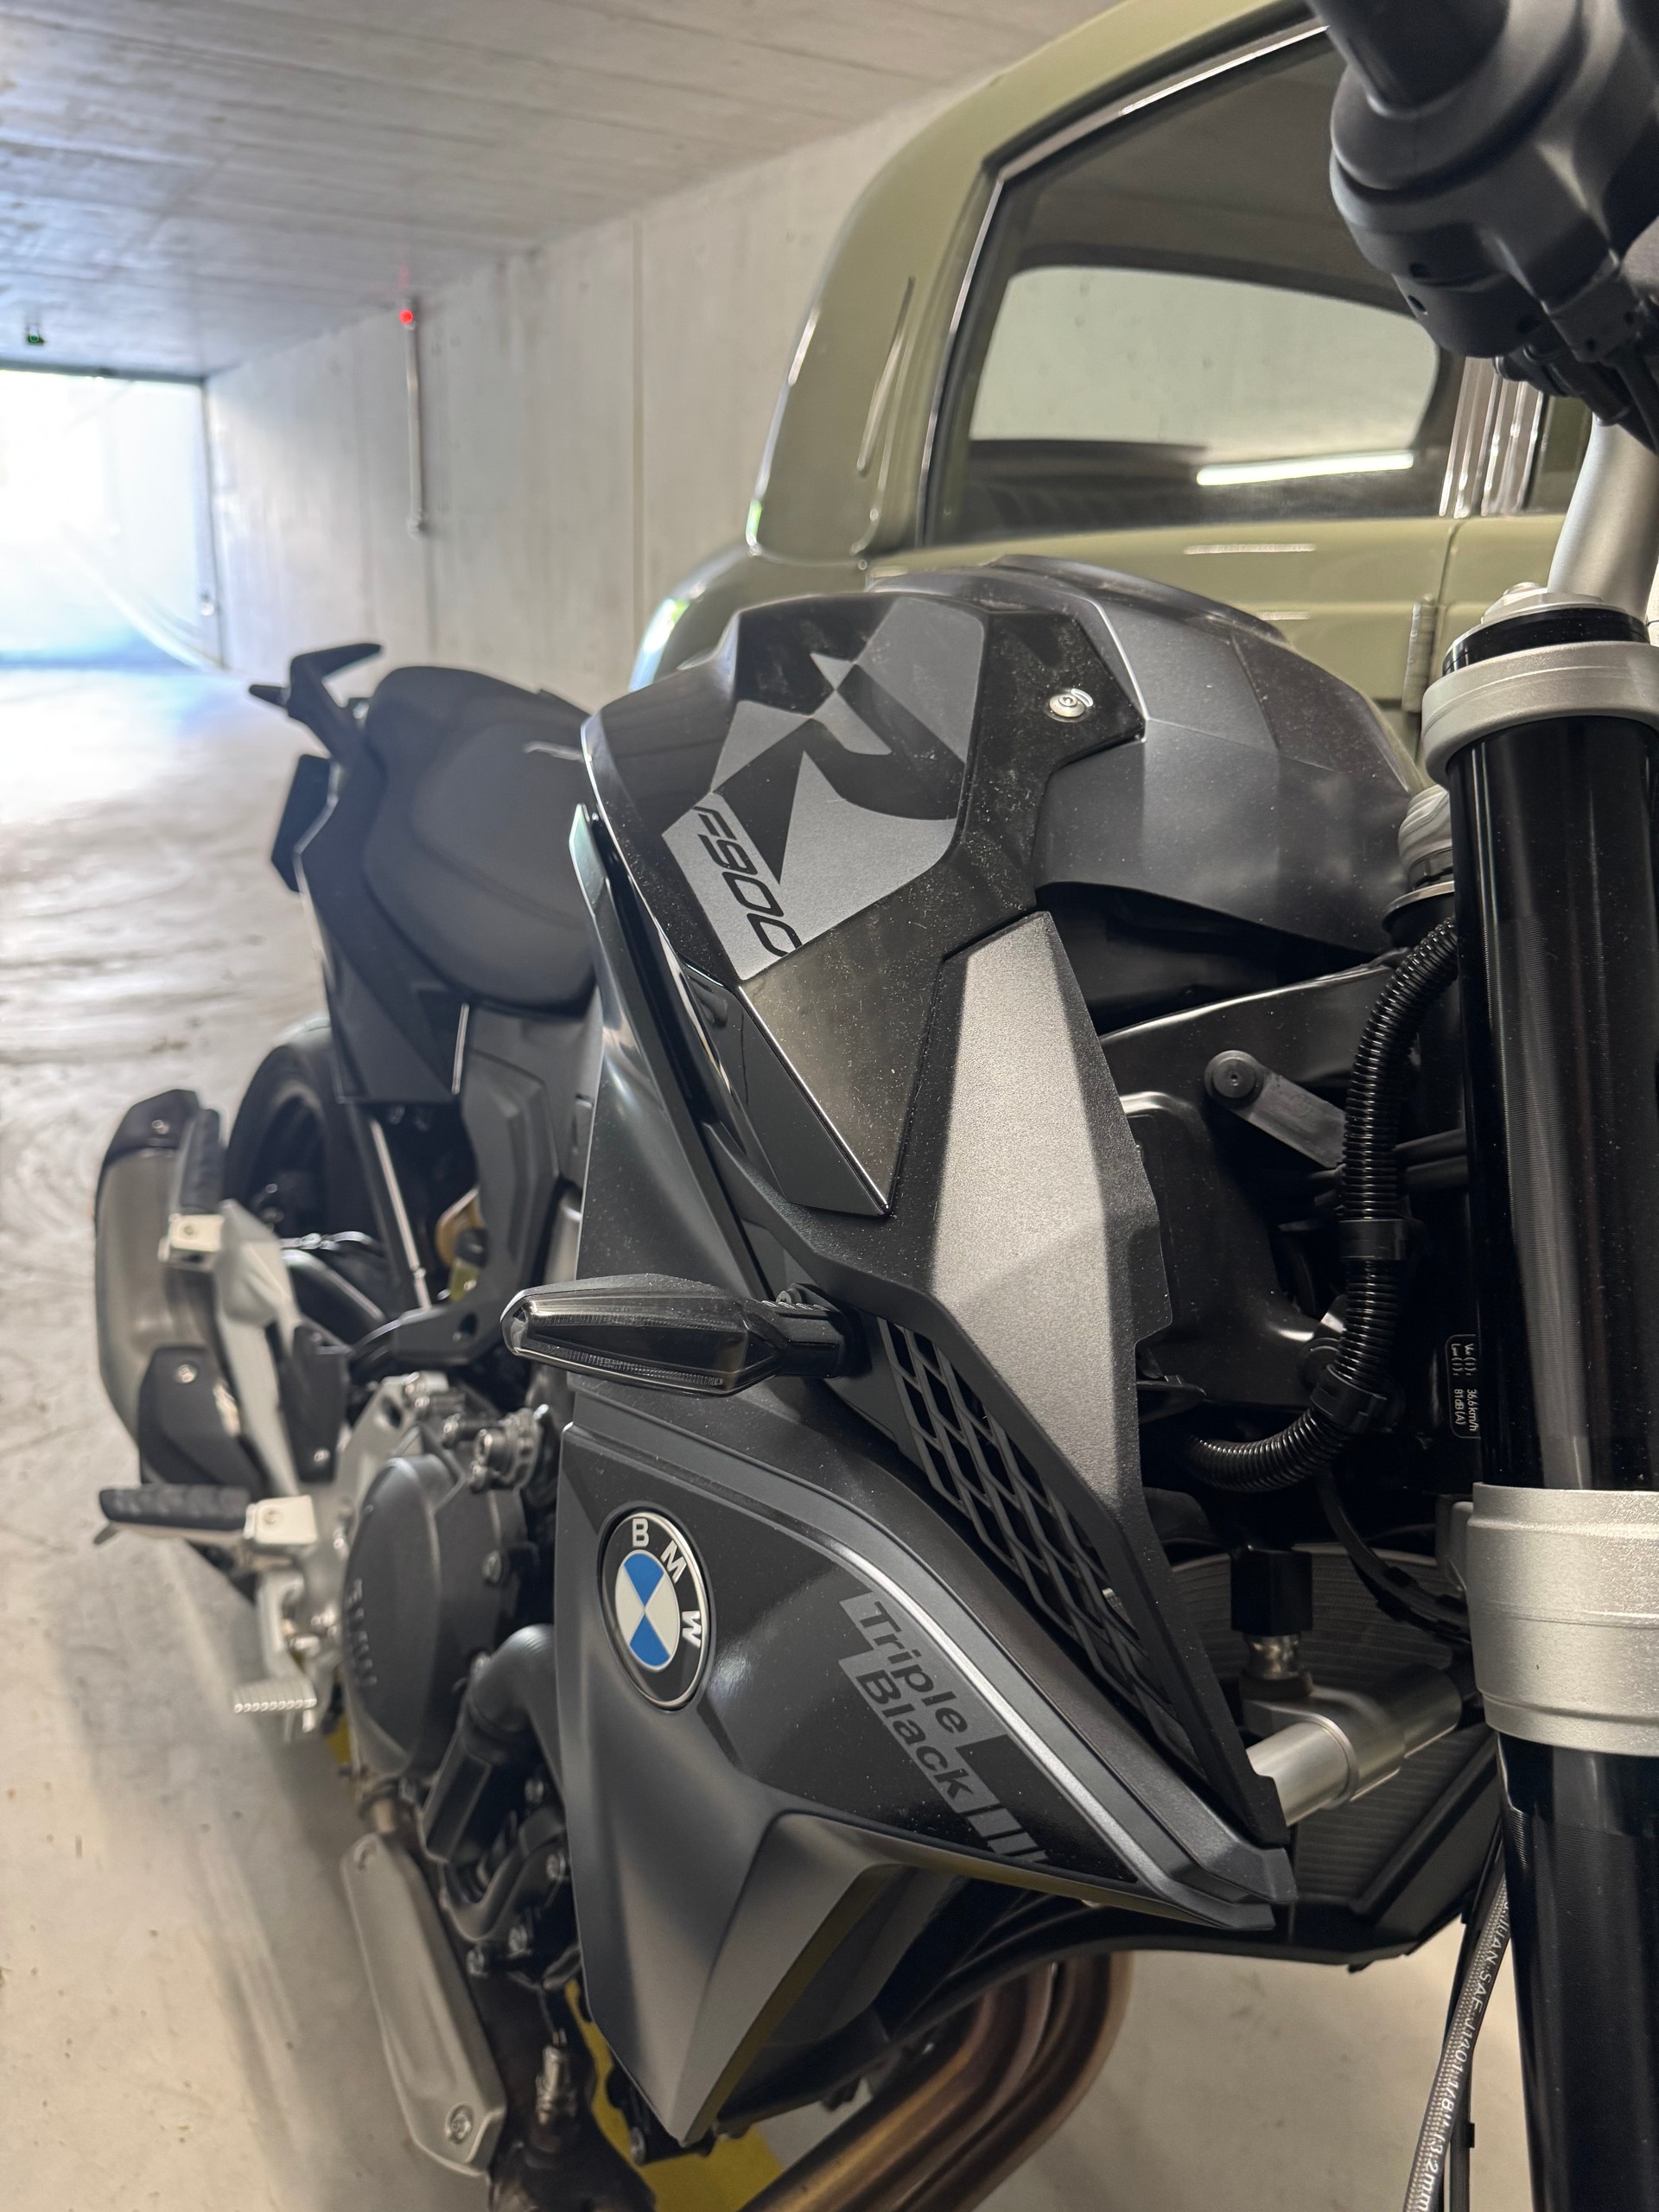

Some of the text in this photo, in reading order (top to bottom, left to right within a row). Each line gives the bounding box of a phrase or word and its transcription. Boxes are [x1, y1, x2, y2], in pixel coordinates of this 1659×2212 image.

[692, 805, 803, 958] F900
[632, 1517, 702, 1649] BMW
[855, 1669, 975, 1798] Black
[860, 1601, 969, 1734] Triple
